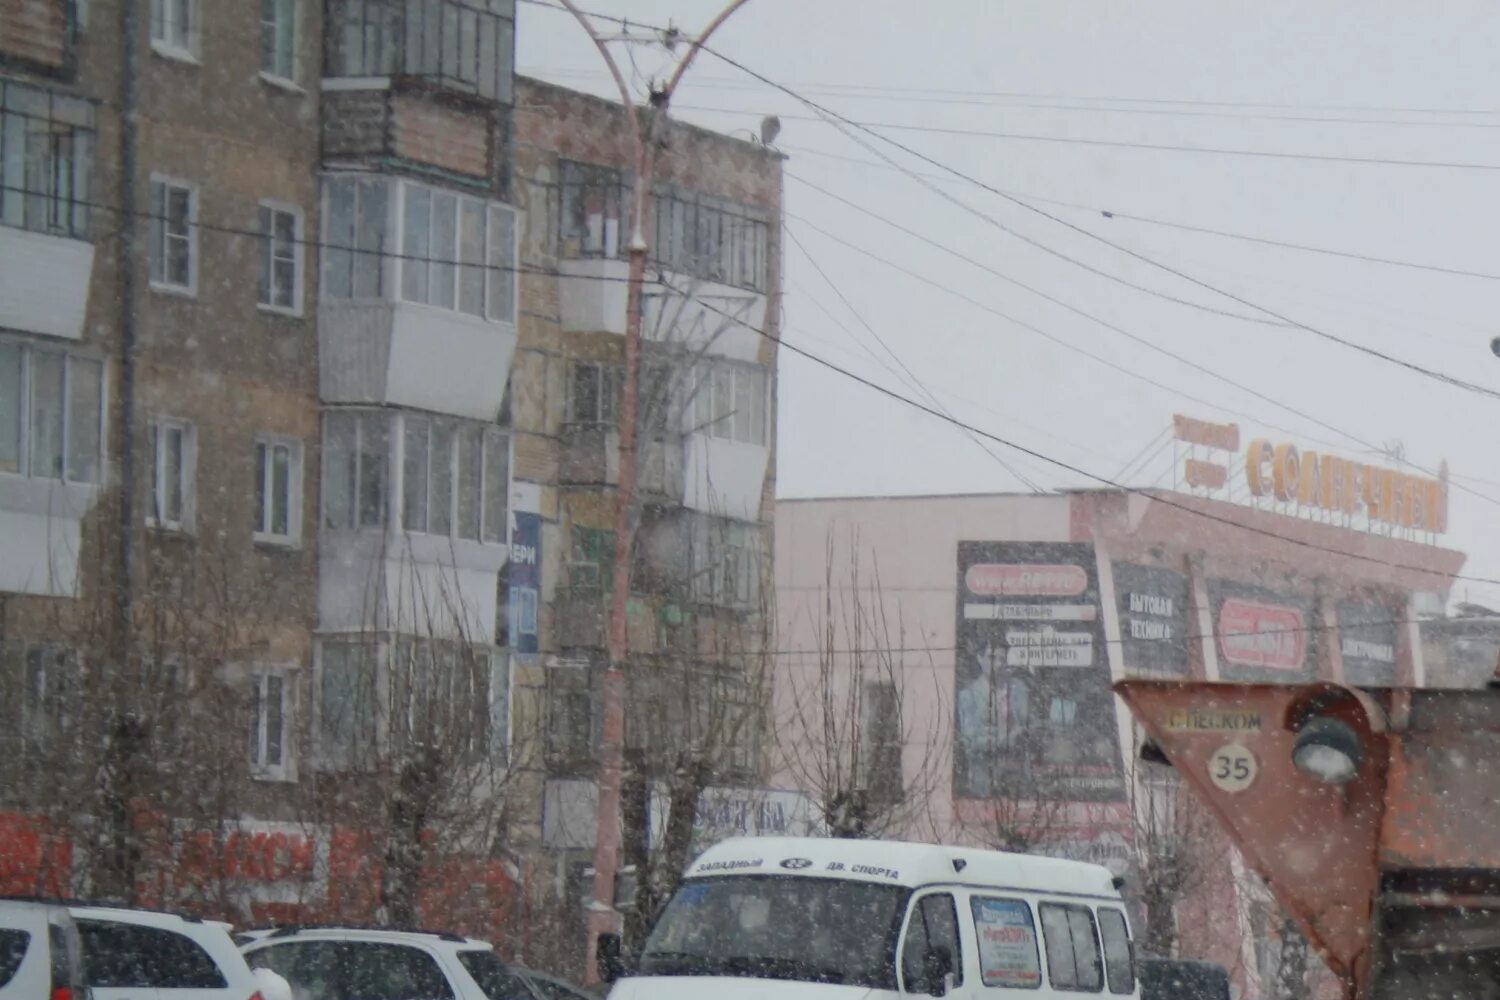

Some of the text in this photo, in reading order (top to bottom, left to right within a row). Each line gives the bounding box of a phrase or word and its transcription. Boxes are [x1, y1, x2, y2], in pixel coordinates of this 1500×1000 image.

[1247, 437, 1448, 534] СОЛНЕЧНЫЙ
[1130, 592, 1173, 617] БЫТОВАЯ
[1131, 620, 1171, 640] ТЕХНИКА
[1187, 712, 1262, 730] ПЕСКОМ
[1215, 756, 1250, 781] 35
[696, 858, 764, 873] ЗАПАДНЫЙ
[825, 861, 847, 873] ДВ.
[851, 863, 901, 880] СПОРТА
